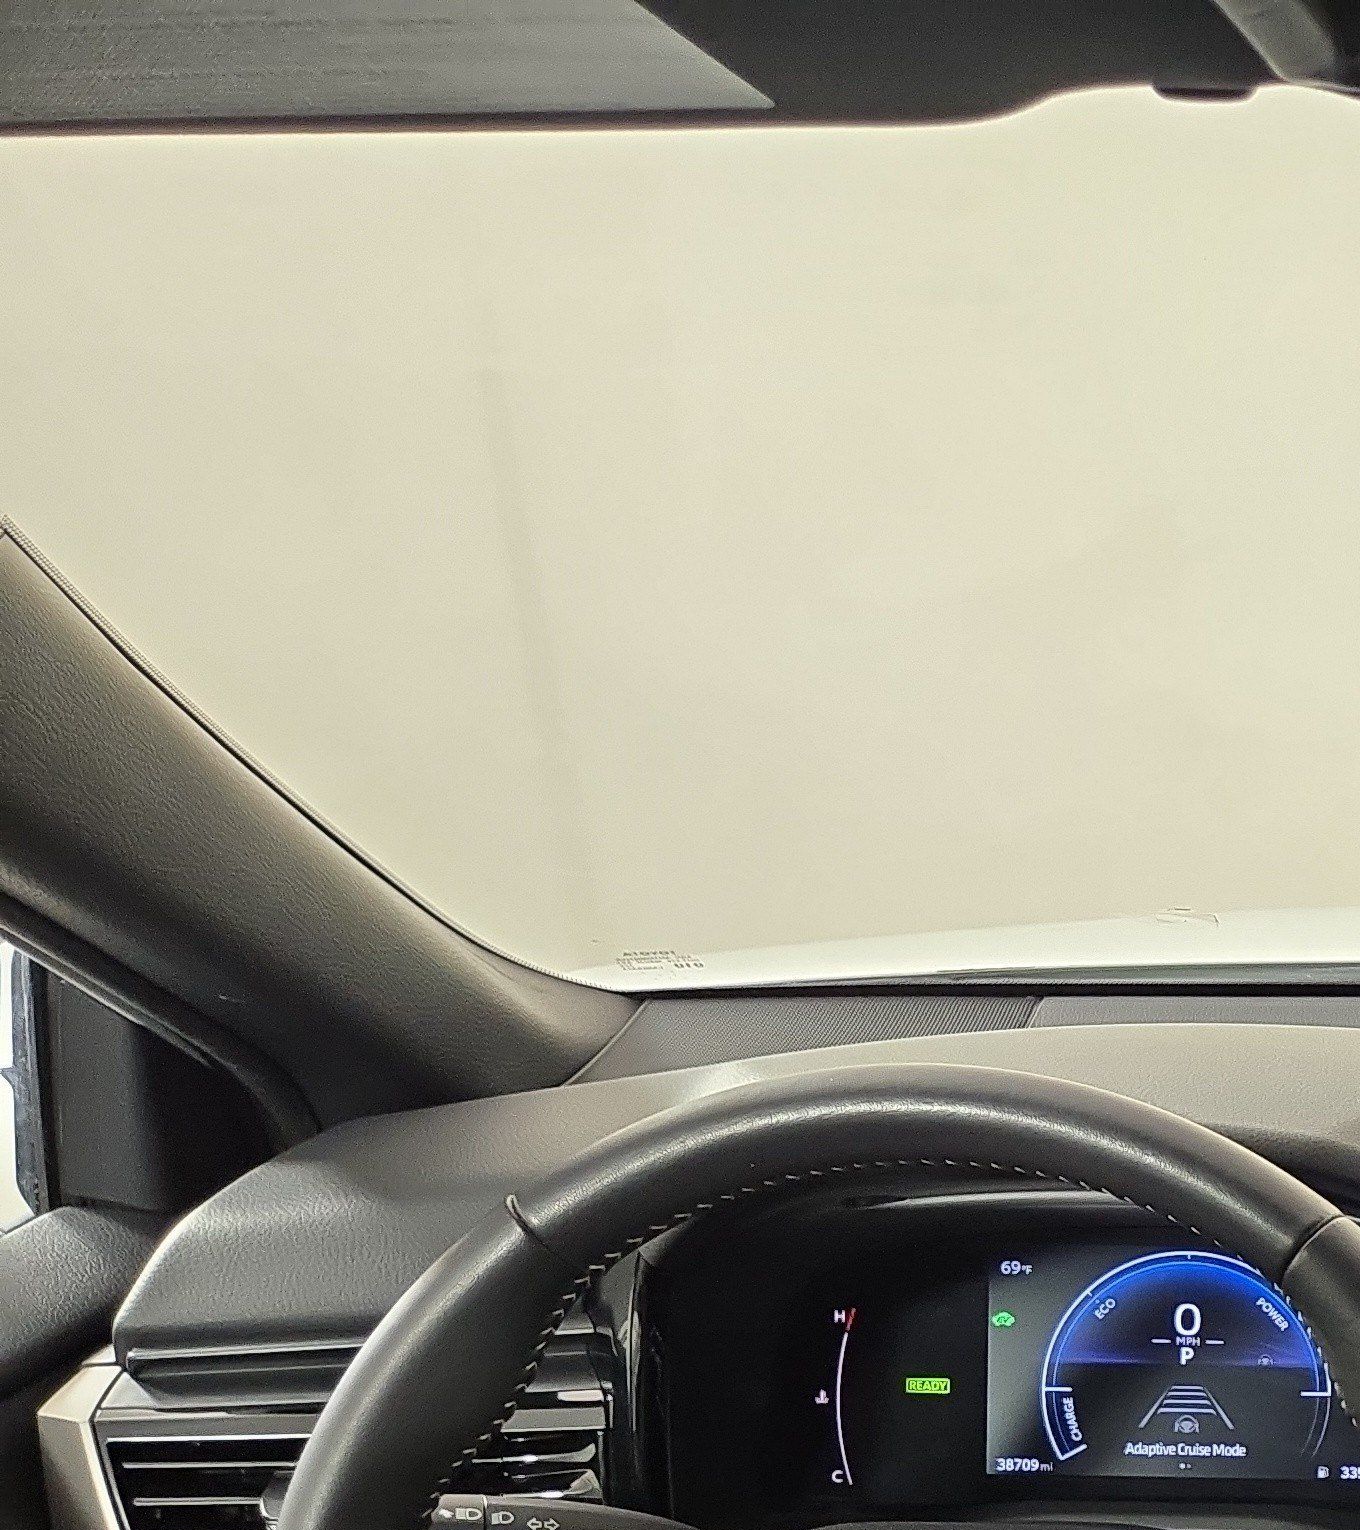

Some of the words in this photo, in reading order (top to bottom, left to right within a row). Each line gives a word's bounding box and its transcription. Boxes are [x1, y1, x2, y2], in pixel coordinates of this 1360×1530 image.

[834, 1310, 846, 1323] H
[1094, 1298, 1116, 1320] ECO
[1255, 1297, 1289, 1332] POWER
[1173, 1303, 1201, 1336] 0
[1175, 1336, 1201, 1347] MPH
[1180, 1346, 1195, 1365] P
[908, 1379, 948, 1392] READY
[1062, 1396, 1083, 1442] CHARGE
[1124, 1442, 1177, 1459] Adaptive
[1177, 1443, 1212, 1457] Cruise
[1212, 1443, 1247, 1457] Mode
[995, 1457, 1040, 1472] 38709
[1040, 1462, 1054, 1472] mi
[831, 1469, 844, 1483] C
